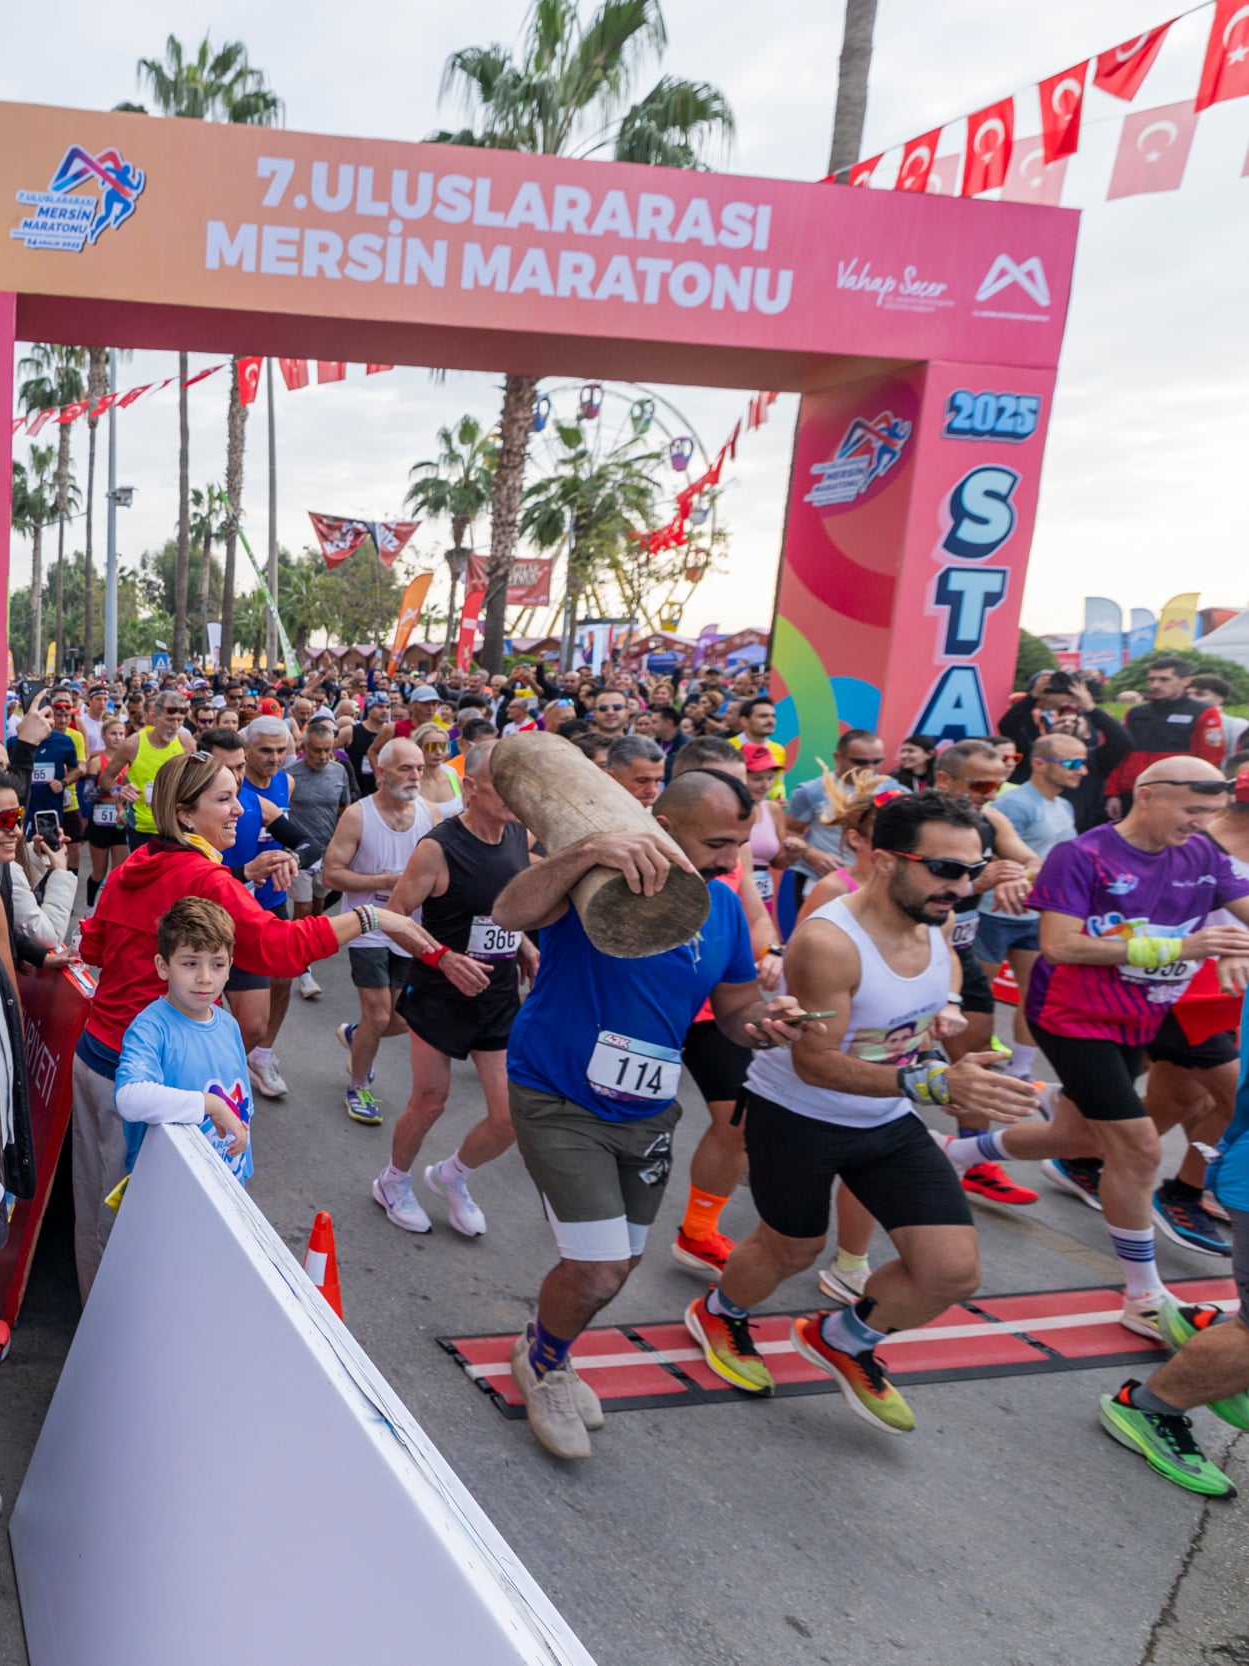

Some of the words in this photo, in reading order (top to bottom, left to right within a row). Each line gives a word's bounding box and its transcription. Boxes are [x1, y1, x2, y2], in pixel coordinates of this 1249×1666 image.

[37, 205, 91, 220] MERSİN
[257, 156, 772, 251] 7.ULUSLARARASI
[22, 219, 87, 233] MARATONU
[205, 218, 448, 288] MERSİN
[461, 242, 794, 315] MARATONU
[836, 256, 897, 308] Vahap
[943, 389, 1041, 442] 2025
[483, 929, 516, 950] 366
[605, 1033, 631, 1049] 42K
[615, 1057, 662, 1095] 114
